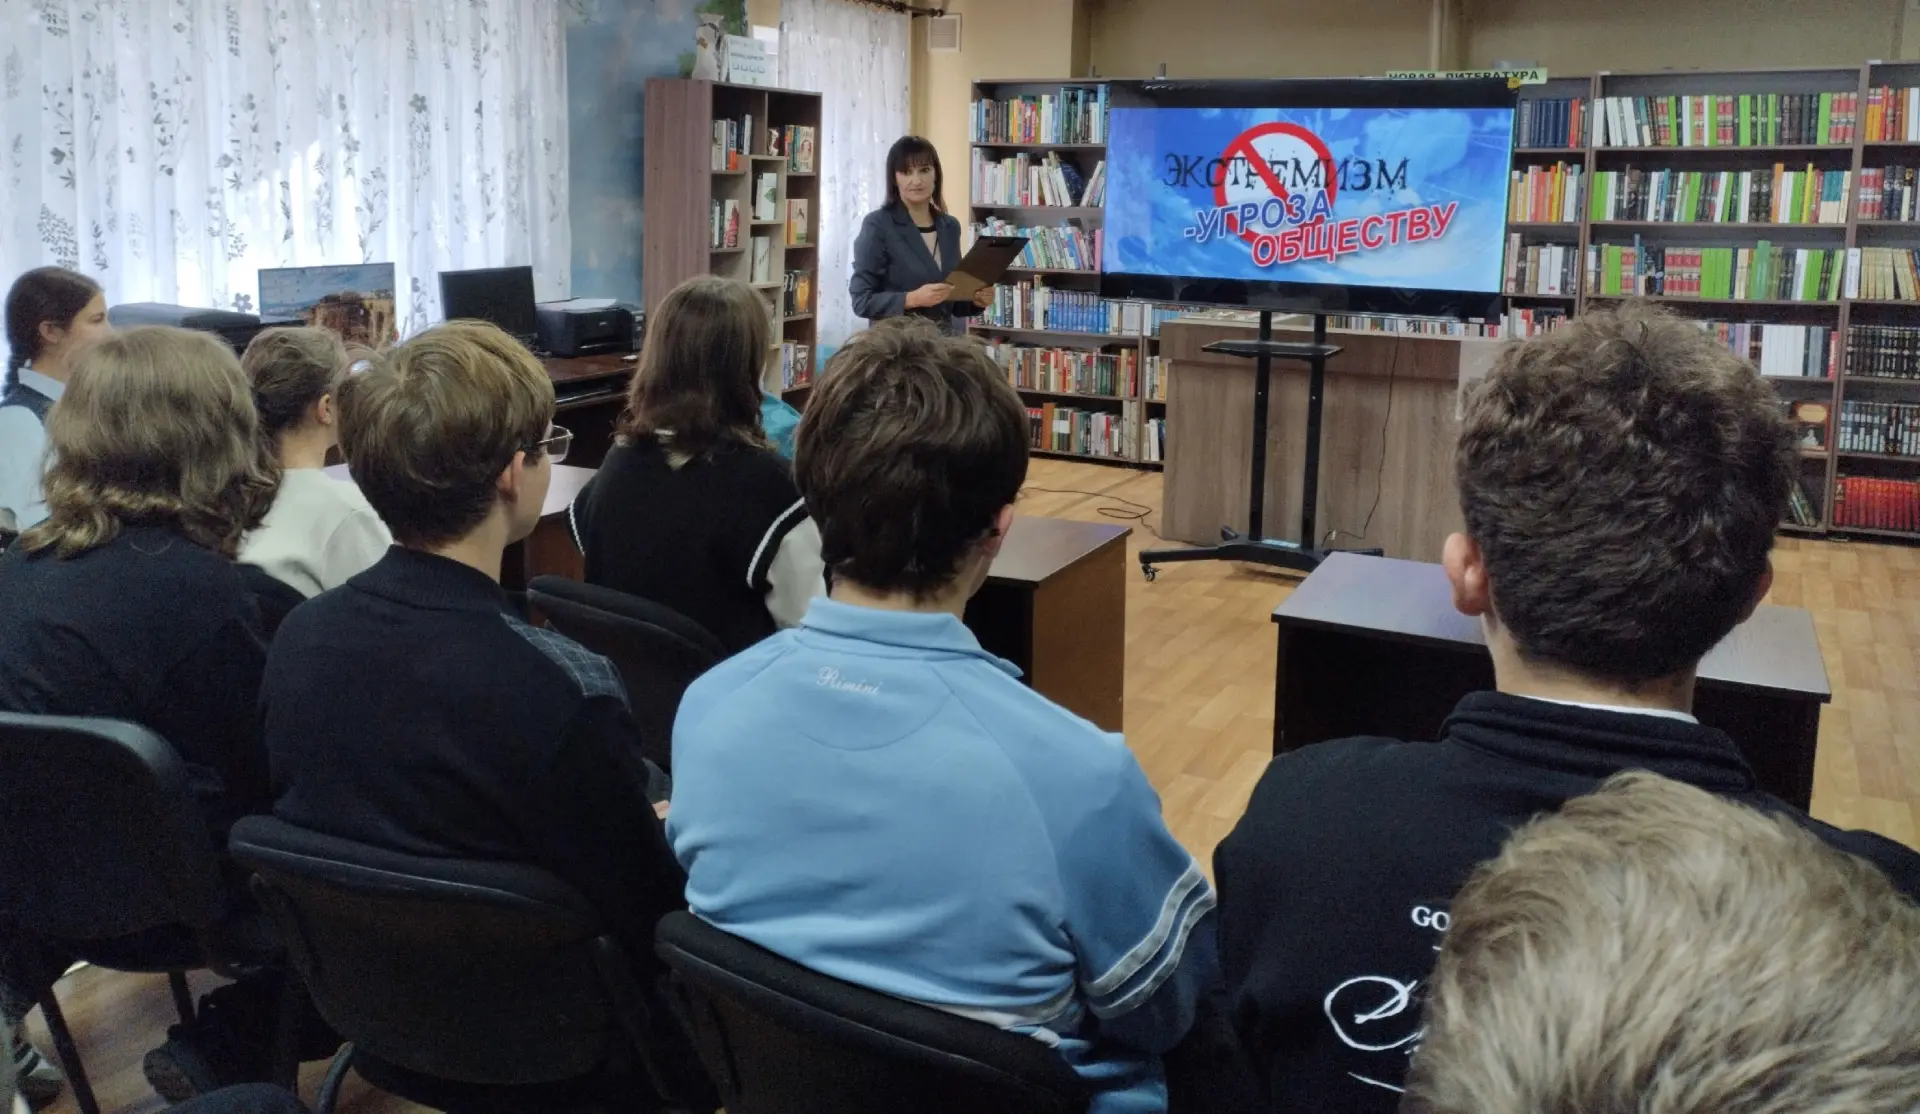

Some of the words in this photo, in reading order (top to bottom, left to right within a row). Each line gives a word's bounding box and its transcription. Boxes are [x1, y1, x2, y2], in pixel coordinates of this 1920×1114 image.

[1163, 153, 1410, 191] ЭКСТРЕМИЗМ
[1252, 201, 1459, 268] ОБЩЕСТВУ
[816, 666, 883, 695] Rimini
[1411, 906, 1451, 931] GO
